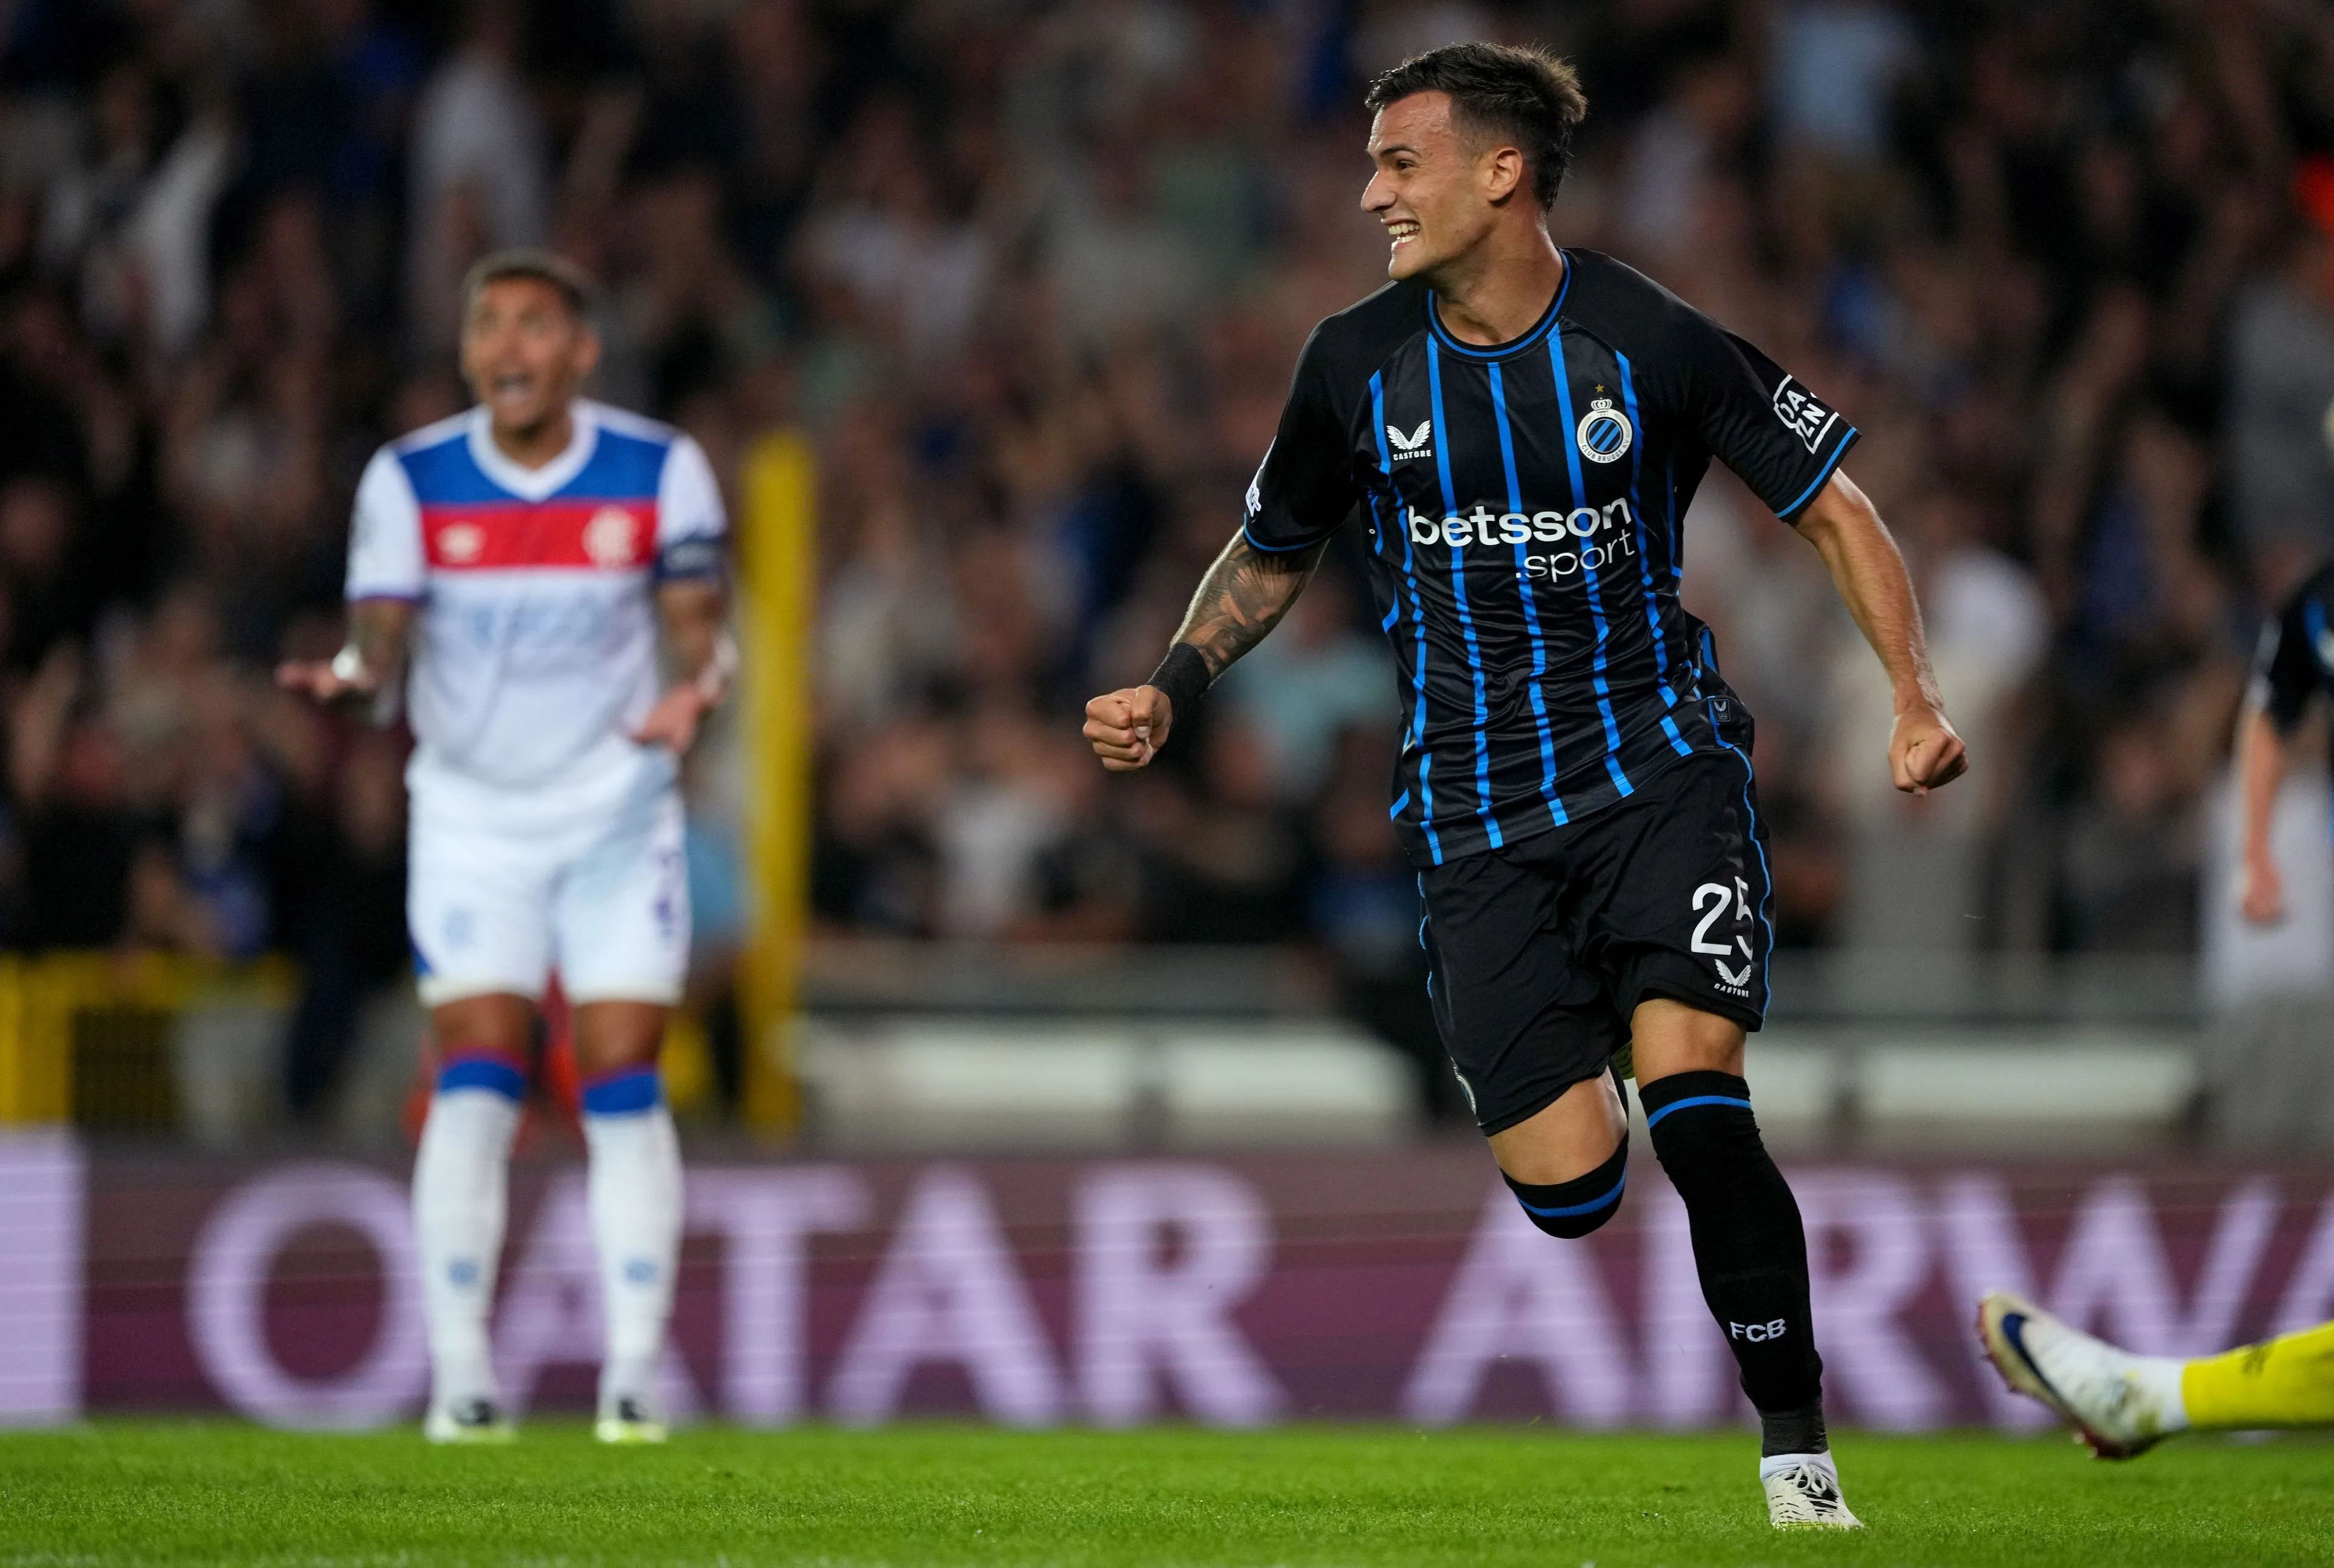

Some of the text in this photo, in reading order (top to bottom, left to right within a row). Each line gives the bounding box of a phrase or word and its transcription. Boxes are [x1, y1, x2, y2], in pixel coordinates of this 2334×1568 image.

[1392, 450, 1431, 461] CASTORE
[1582, 444, 1596, 459] CLUB
[1597, 449, 1623, 462] BRUGGE
[1408, 498, 1632, 547] betsson
[1516, 529, 1636, 583] .sport
[1691, 876, 1754, 961] 25
[1730, 1318, 1787, 1343] FCB
